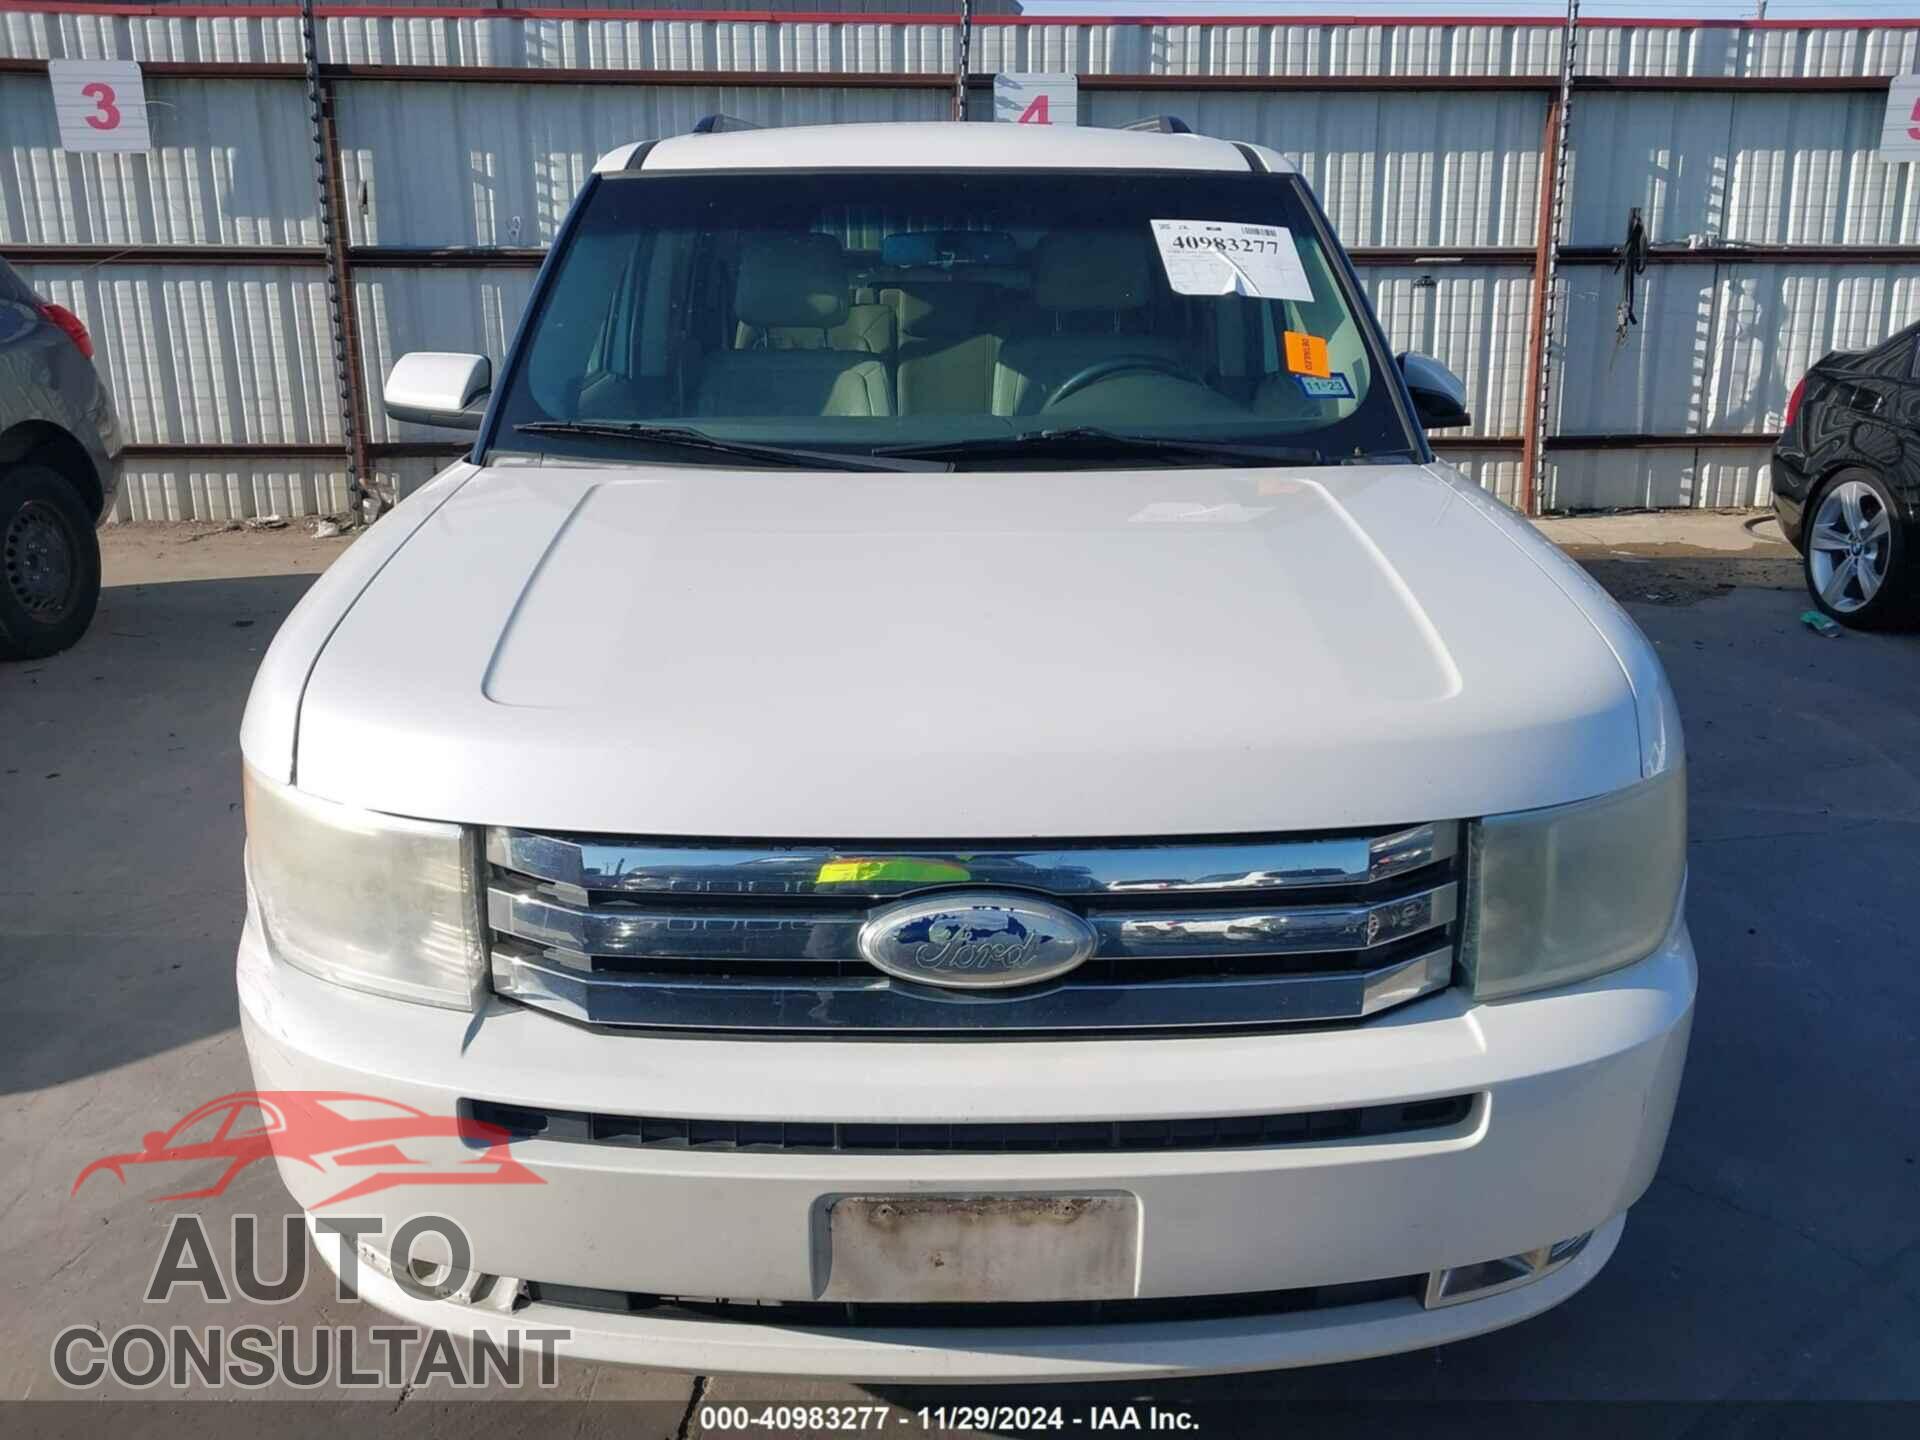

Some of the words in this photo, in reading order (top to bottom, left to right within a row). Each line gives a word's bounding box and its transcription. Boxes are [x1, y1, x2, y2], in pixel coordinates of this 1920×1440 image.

[82, 83, 120, 130] 3
[1018, 95, 1053, 124] 4
[1173, 235, 1278, 255] 40983277
[914, 921, 1038, 970] Ford
